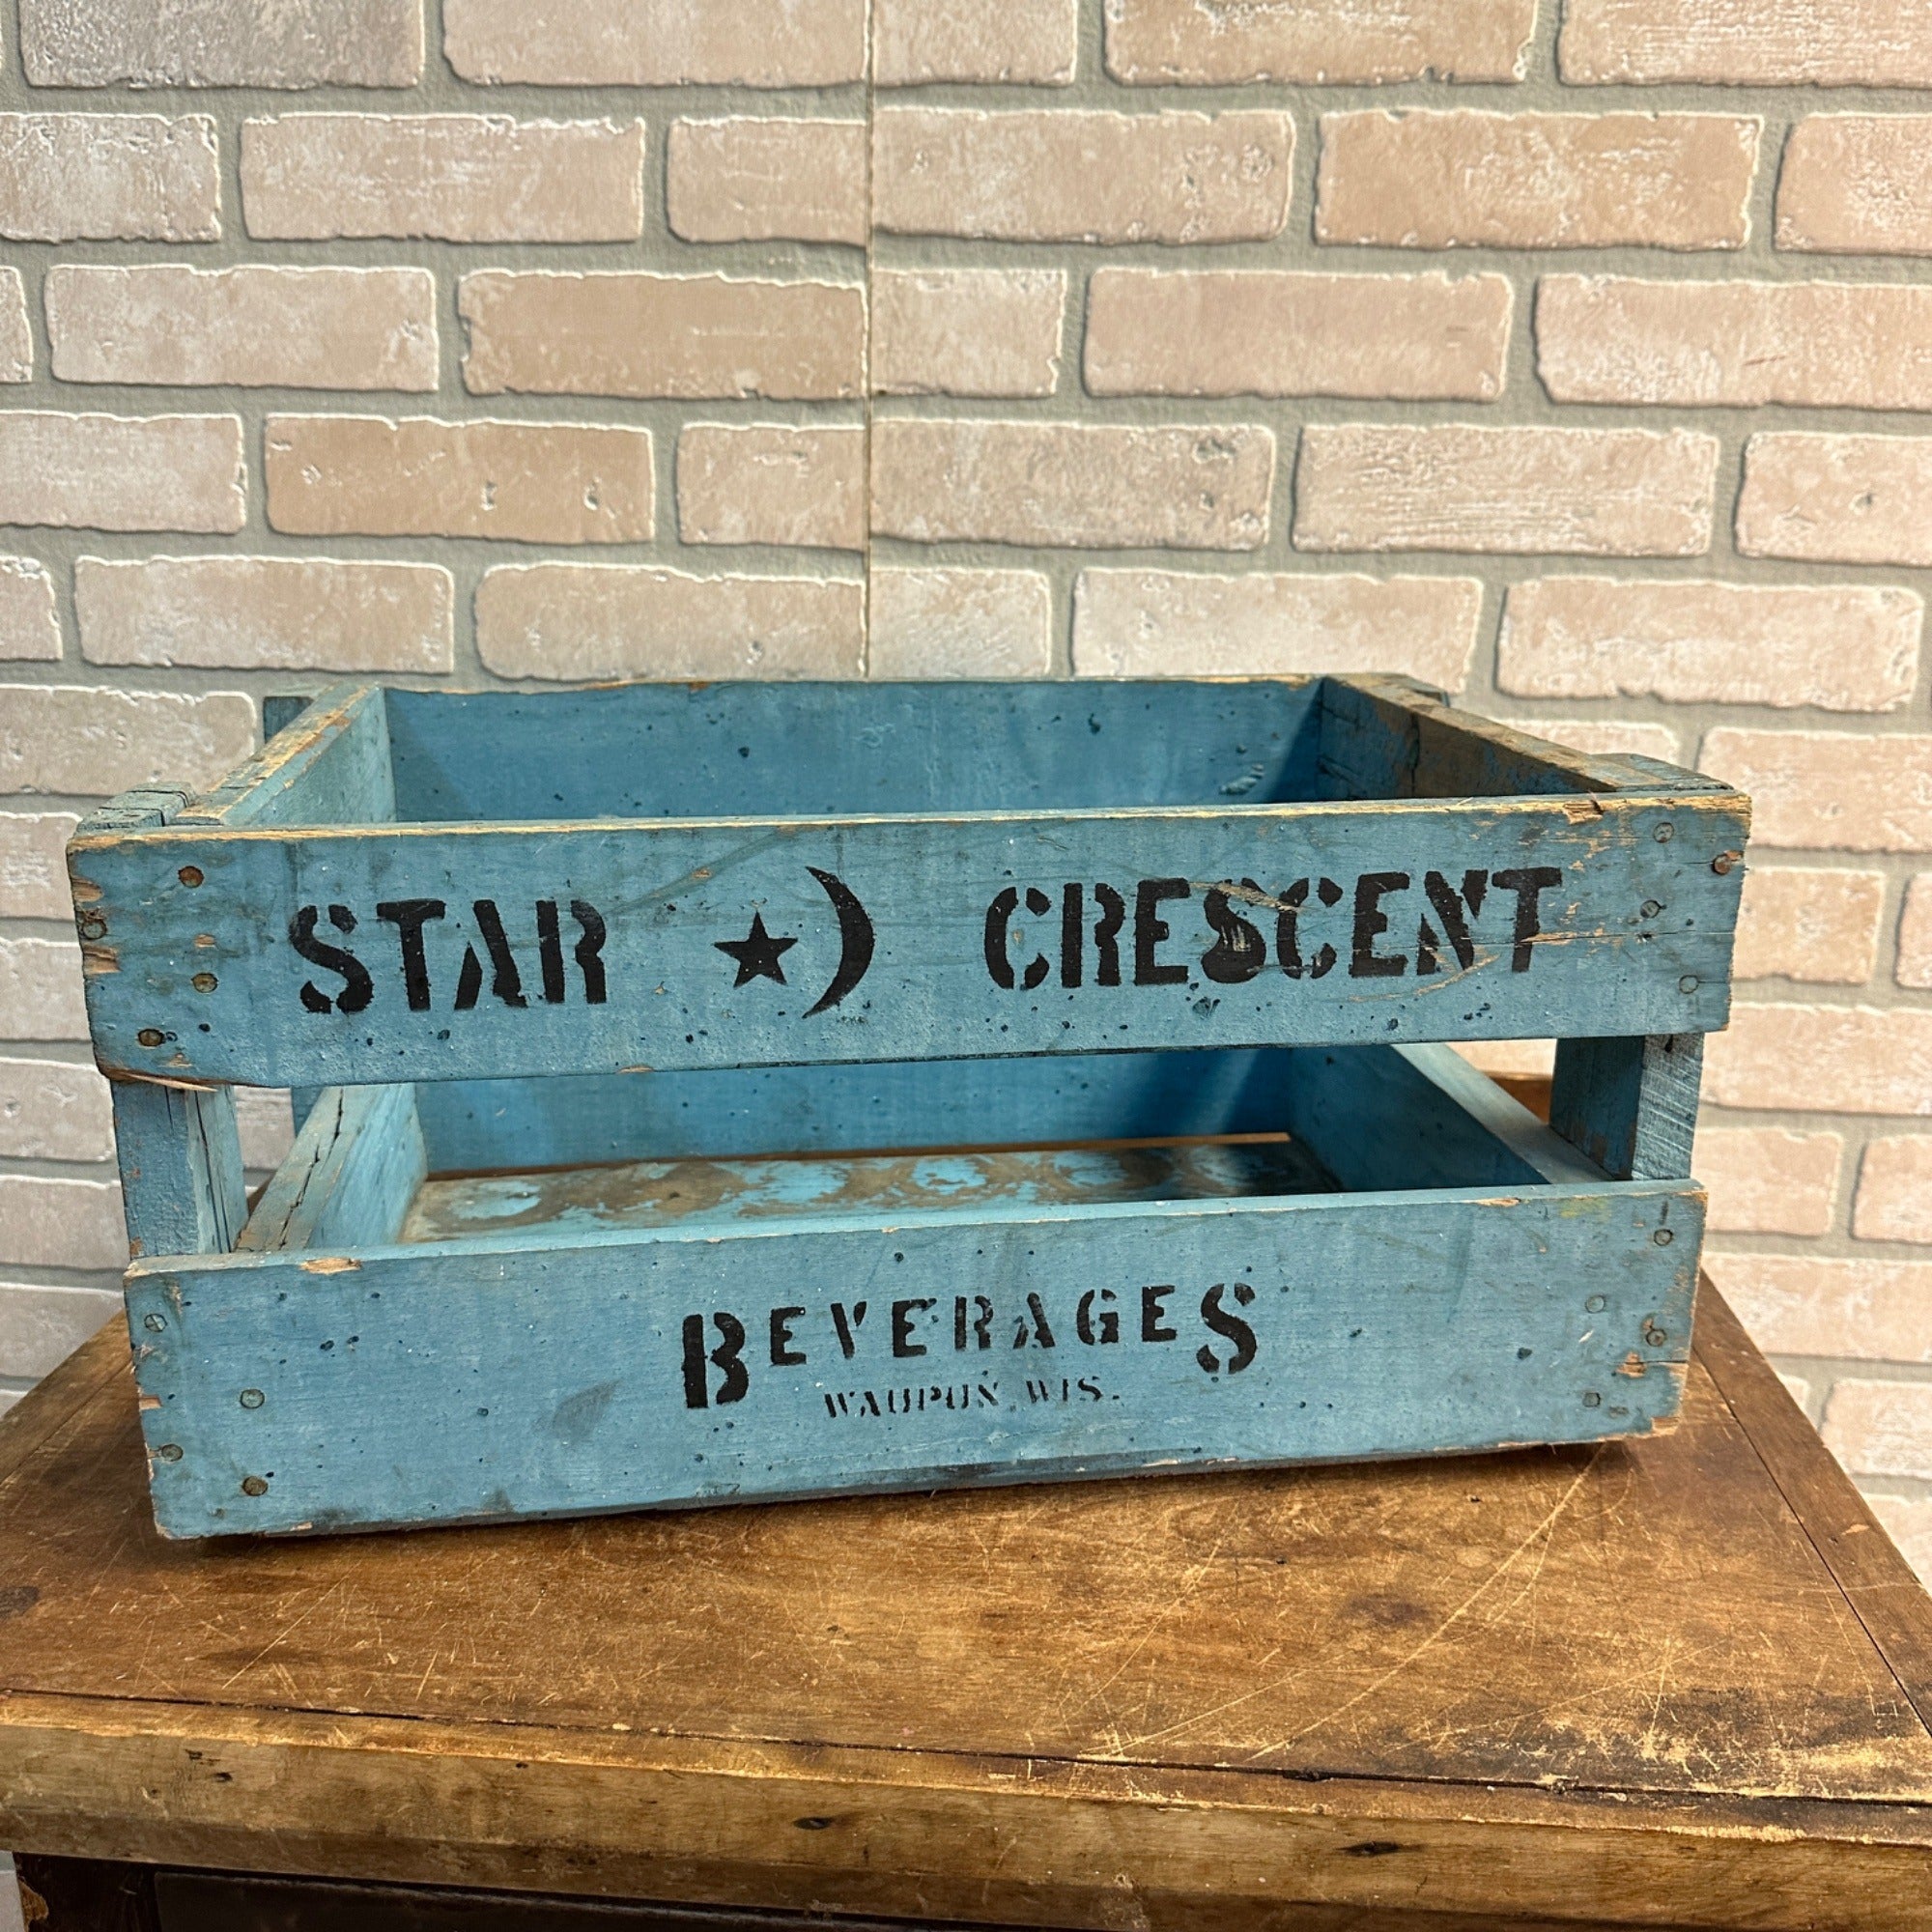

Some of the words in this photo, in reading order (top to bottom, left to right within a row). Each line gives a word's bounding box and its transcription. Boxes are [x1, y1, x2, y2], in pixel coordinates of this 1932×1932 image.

[289, 898, 608, 1013] STAR
[984, 867, 1563, 989] CRESCENT
[682, 1284, 1257, 1408] BEVERAGES
